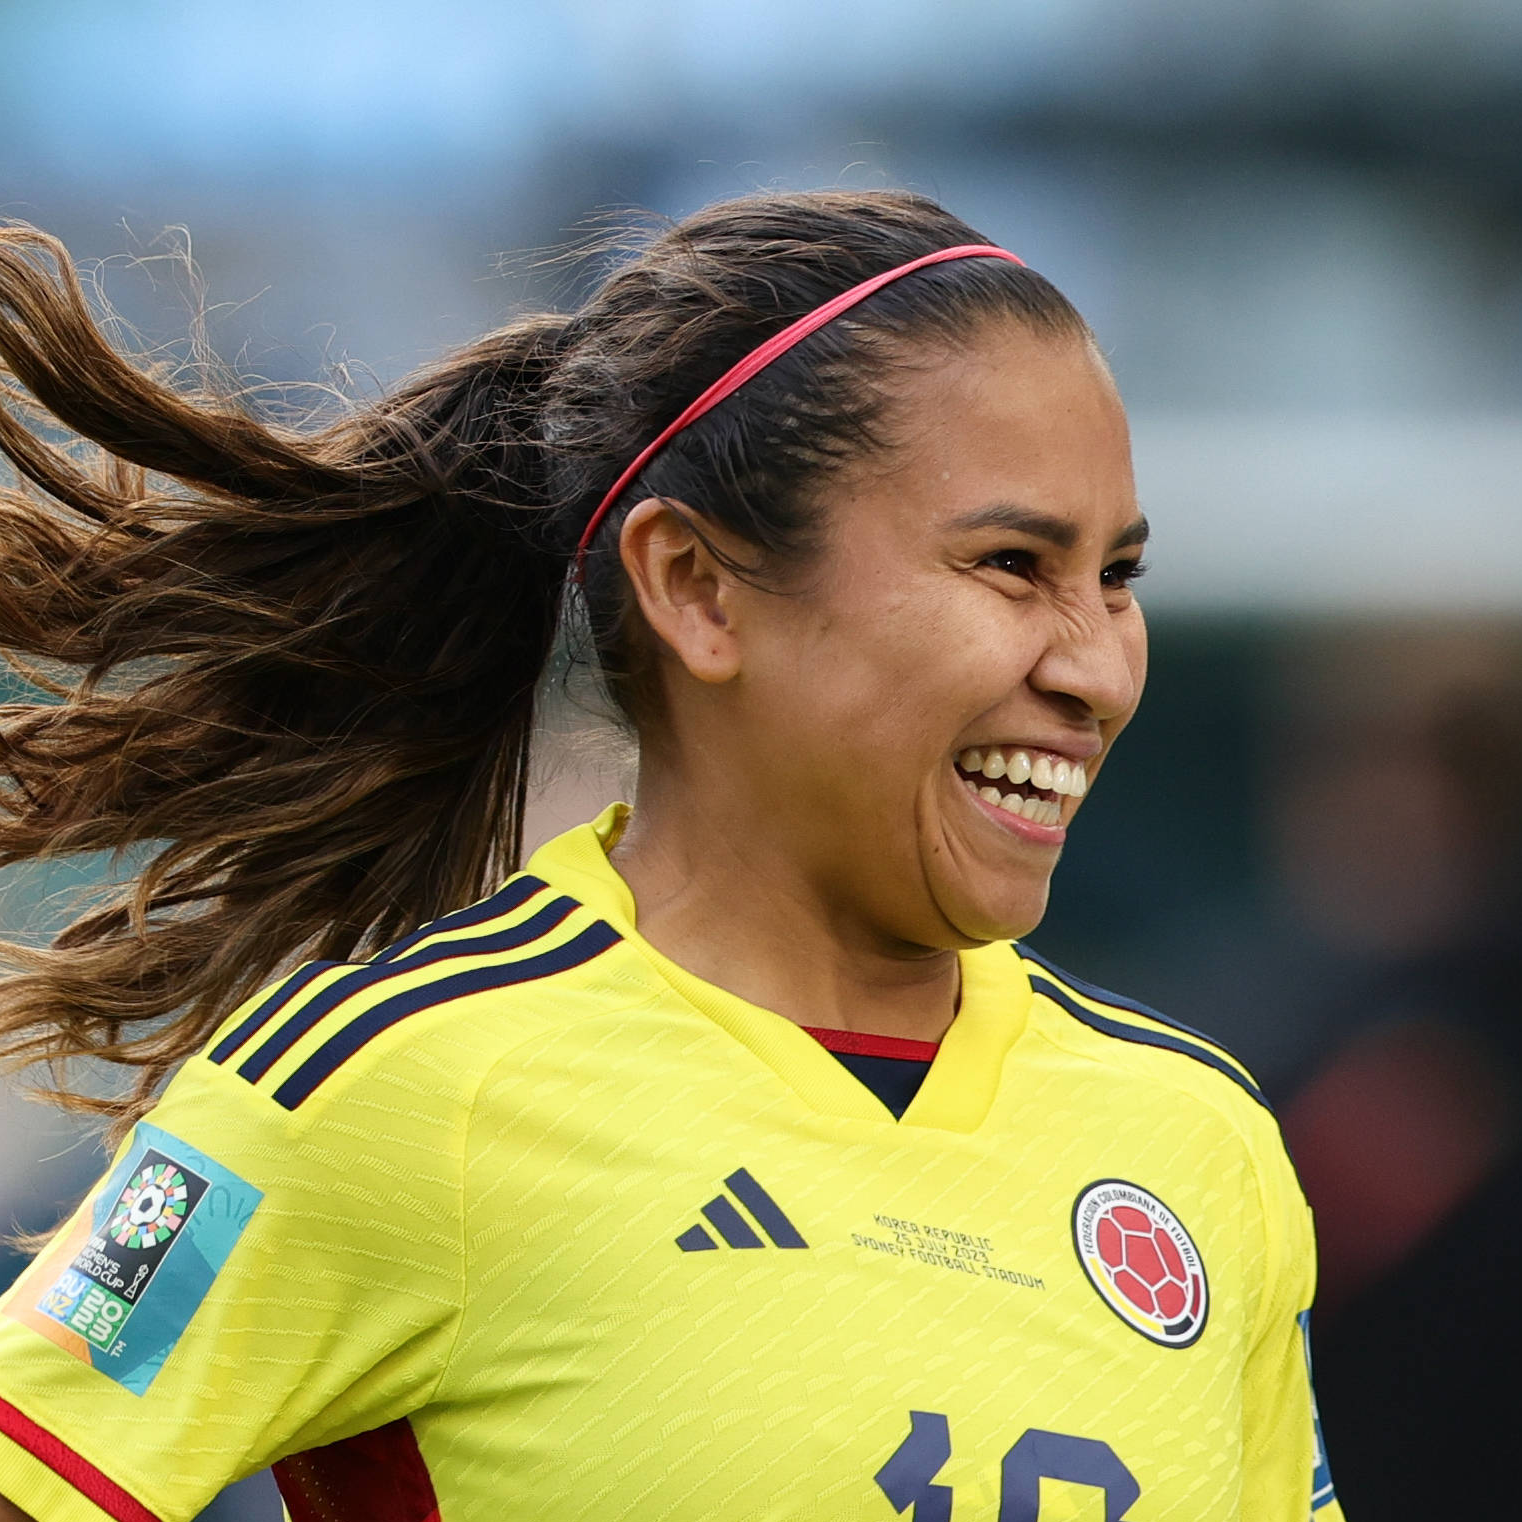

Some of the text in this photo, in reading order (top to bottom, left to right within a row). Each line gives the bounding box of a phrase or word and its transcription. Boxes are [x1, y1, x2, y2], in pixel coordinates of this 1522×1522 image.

[1098, 1189, 1158, 1215] COLOMBIANA
[1158, 1210, 1172, 1226] DE
[873, 1214, 995, 1251] KOREA REPUBLIC
[893, 1231, 990, 1264] 25 JULY 2023
[851, 1233, 1047, 1291] SYDNEY FOOTBALL STADIUM
[58, 1273, 86, 1298] AU
[100, 1270, 125, 1289] CUP
[42, 1292, 73, 1318] NZ
